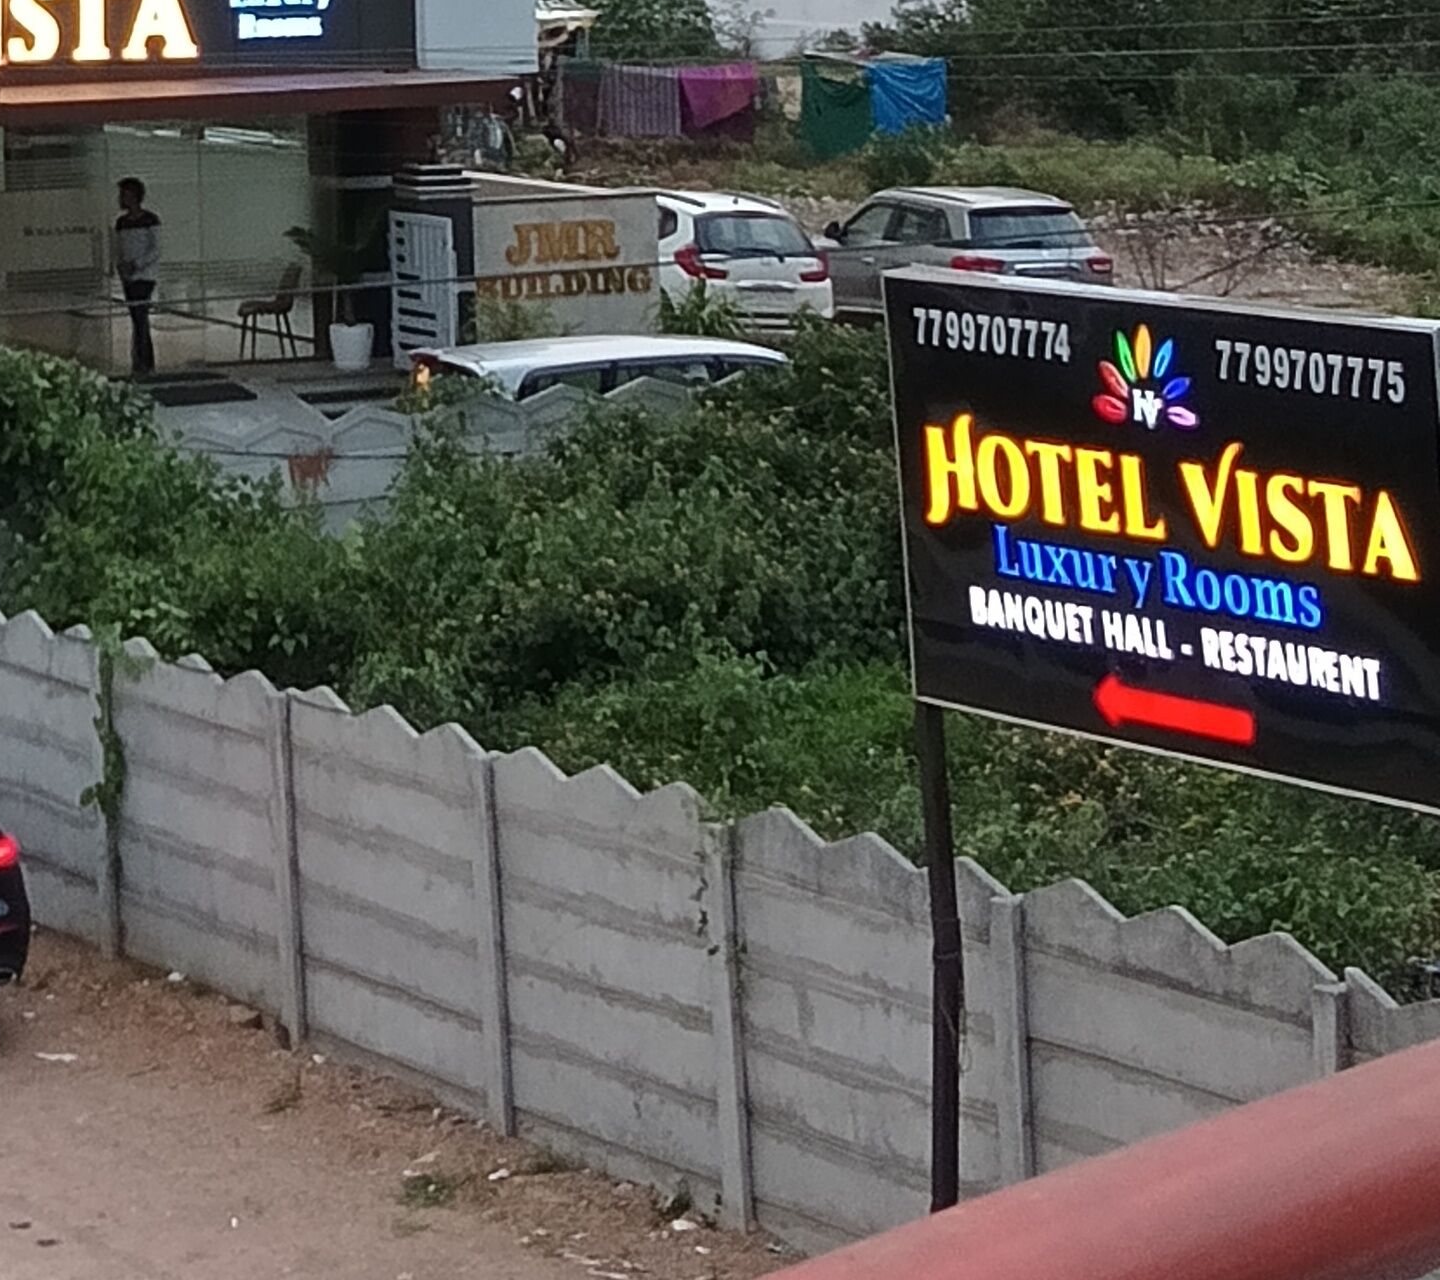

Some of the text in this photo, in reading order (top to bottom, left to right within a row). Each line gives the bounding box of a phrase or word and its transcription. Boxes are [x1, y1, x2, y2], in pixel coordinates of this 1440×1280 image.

[505, 219, 621, 266] JMR
[913, 307, 1071, 363] 7799707774
[1215, 340, 1406, 404] 7799707775
[924, 413, 1421, 583] HOTEL VISTA
[1161, 550, 1323, 630] Rooms
[969, 586, 1093, 644] BANQUET
[1102, 610, 1175, 660] HALL
[1200, 627, 1381, 701] RESTAURENT
